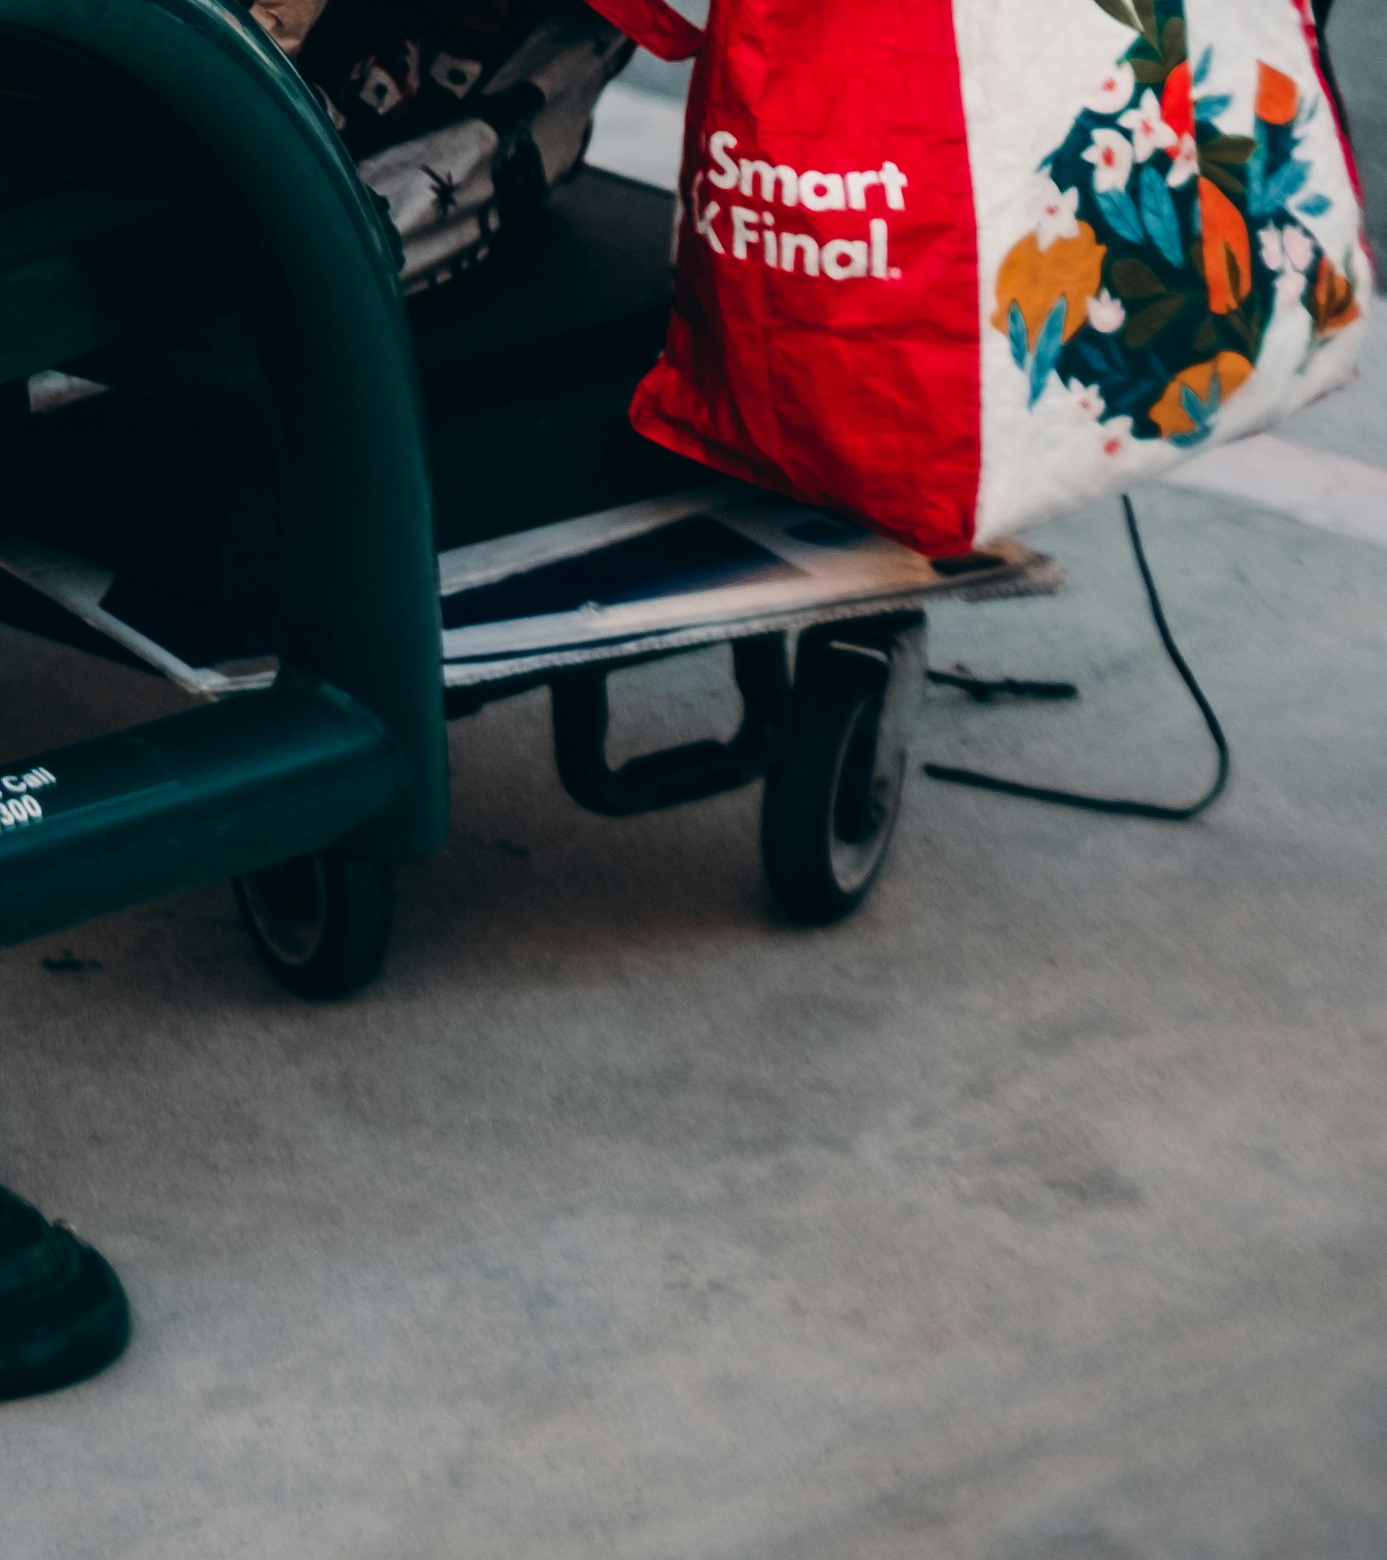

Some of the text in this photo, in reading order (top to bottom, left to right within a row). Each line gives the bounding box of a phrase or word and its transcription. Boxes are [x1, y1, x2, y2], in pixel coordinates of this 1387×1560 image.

[707, 130, 908, 211] Smart
[730, 205, 903, 281] Final.
[1, 766, 57, 793] Call
